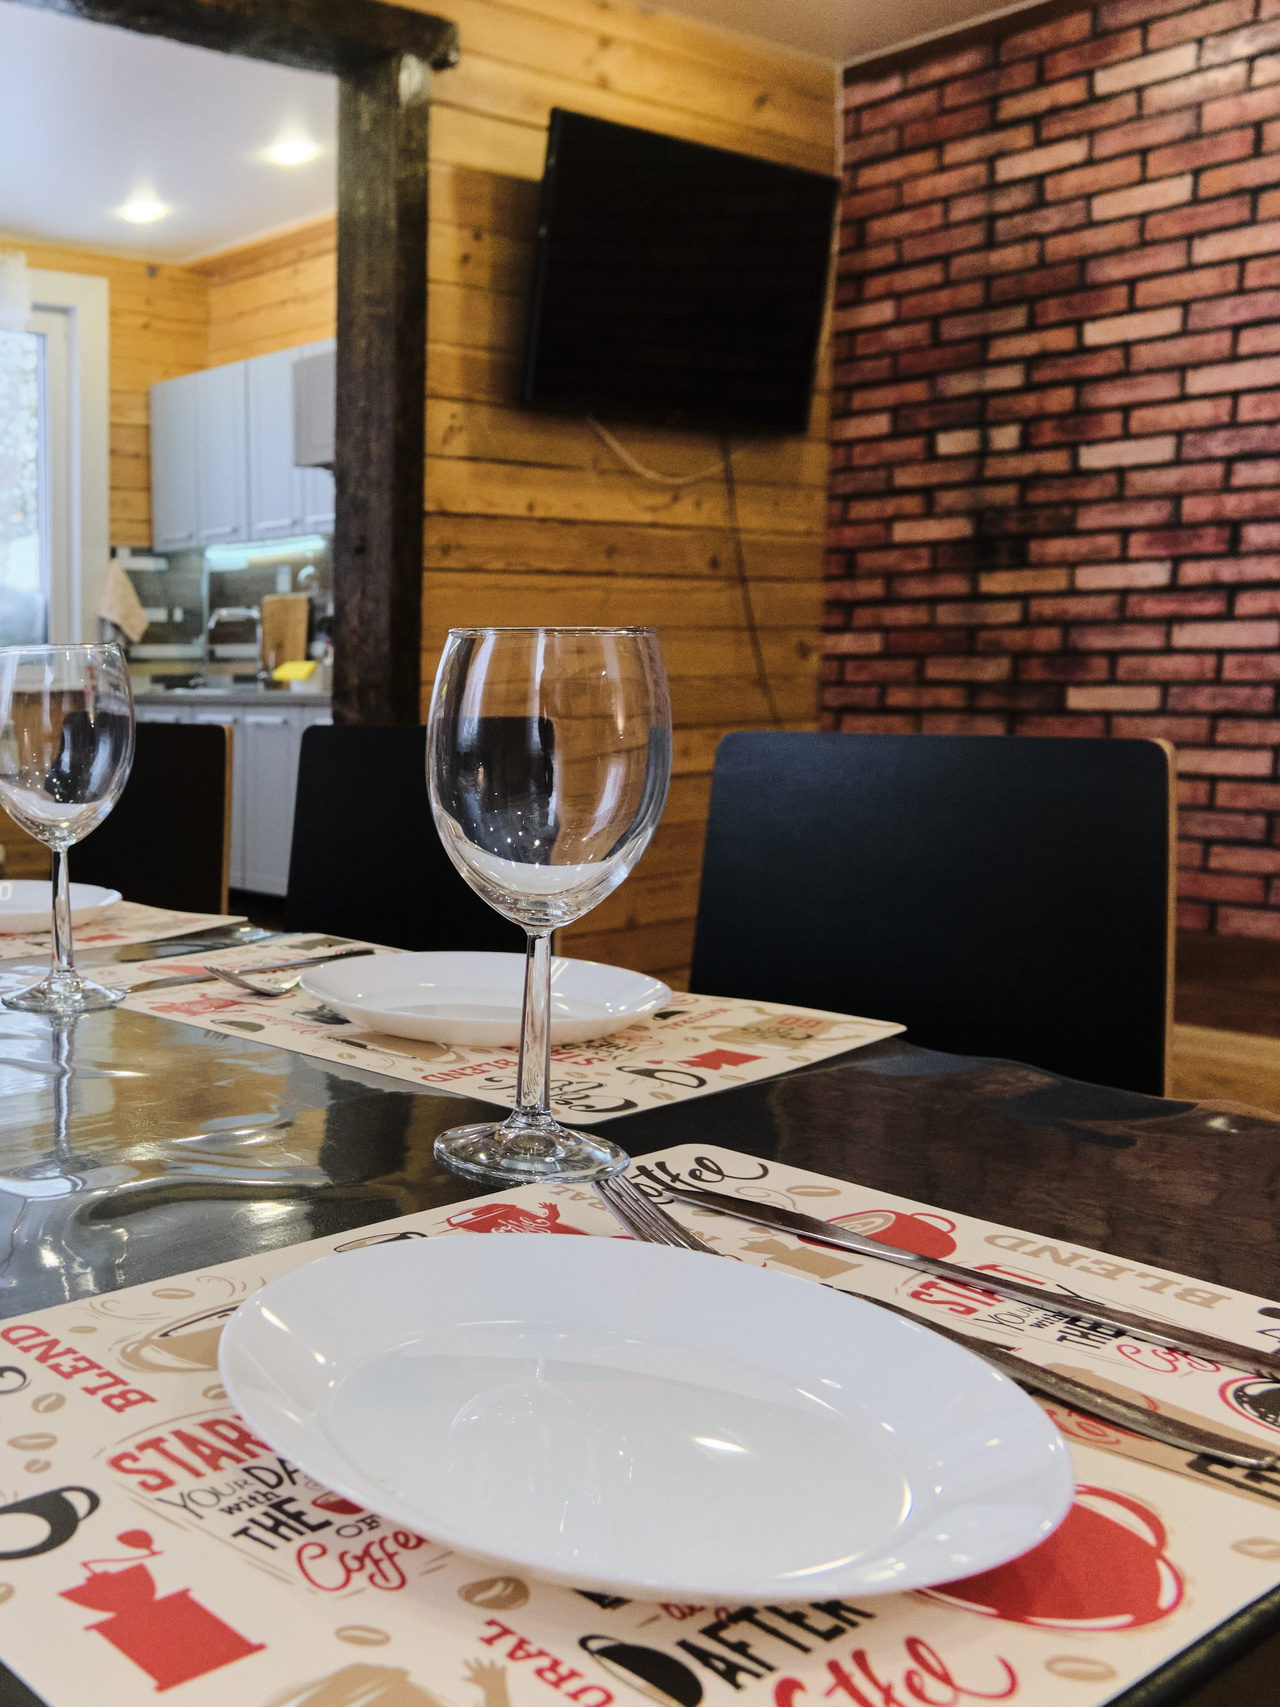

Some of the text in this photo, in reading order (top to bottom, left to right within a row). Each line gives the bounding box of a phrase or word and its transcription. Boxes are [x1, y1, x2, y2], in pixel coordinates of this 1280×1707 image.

[421, 1058, 518, 1083] BLEND
[984, 1234, 1233, 1310] BLEND
[0, 1325, 158, 1413] BLEND
[108, 1414, 273, 1492] STAR
[157, 1456, 299, 1519] YOUR DA
[219, 1489, 281, 1515] with
[231, 1497, 333, 1550] THE
[481, 1619, 614, 1707] URAL
[677, 1600, 876, 1690] AFTER
